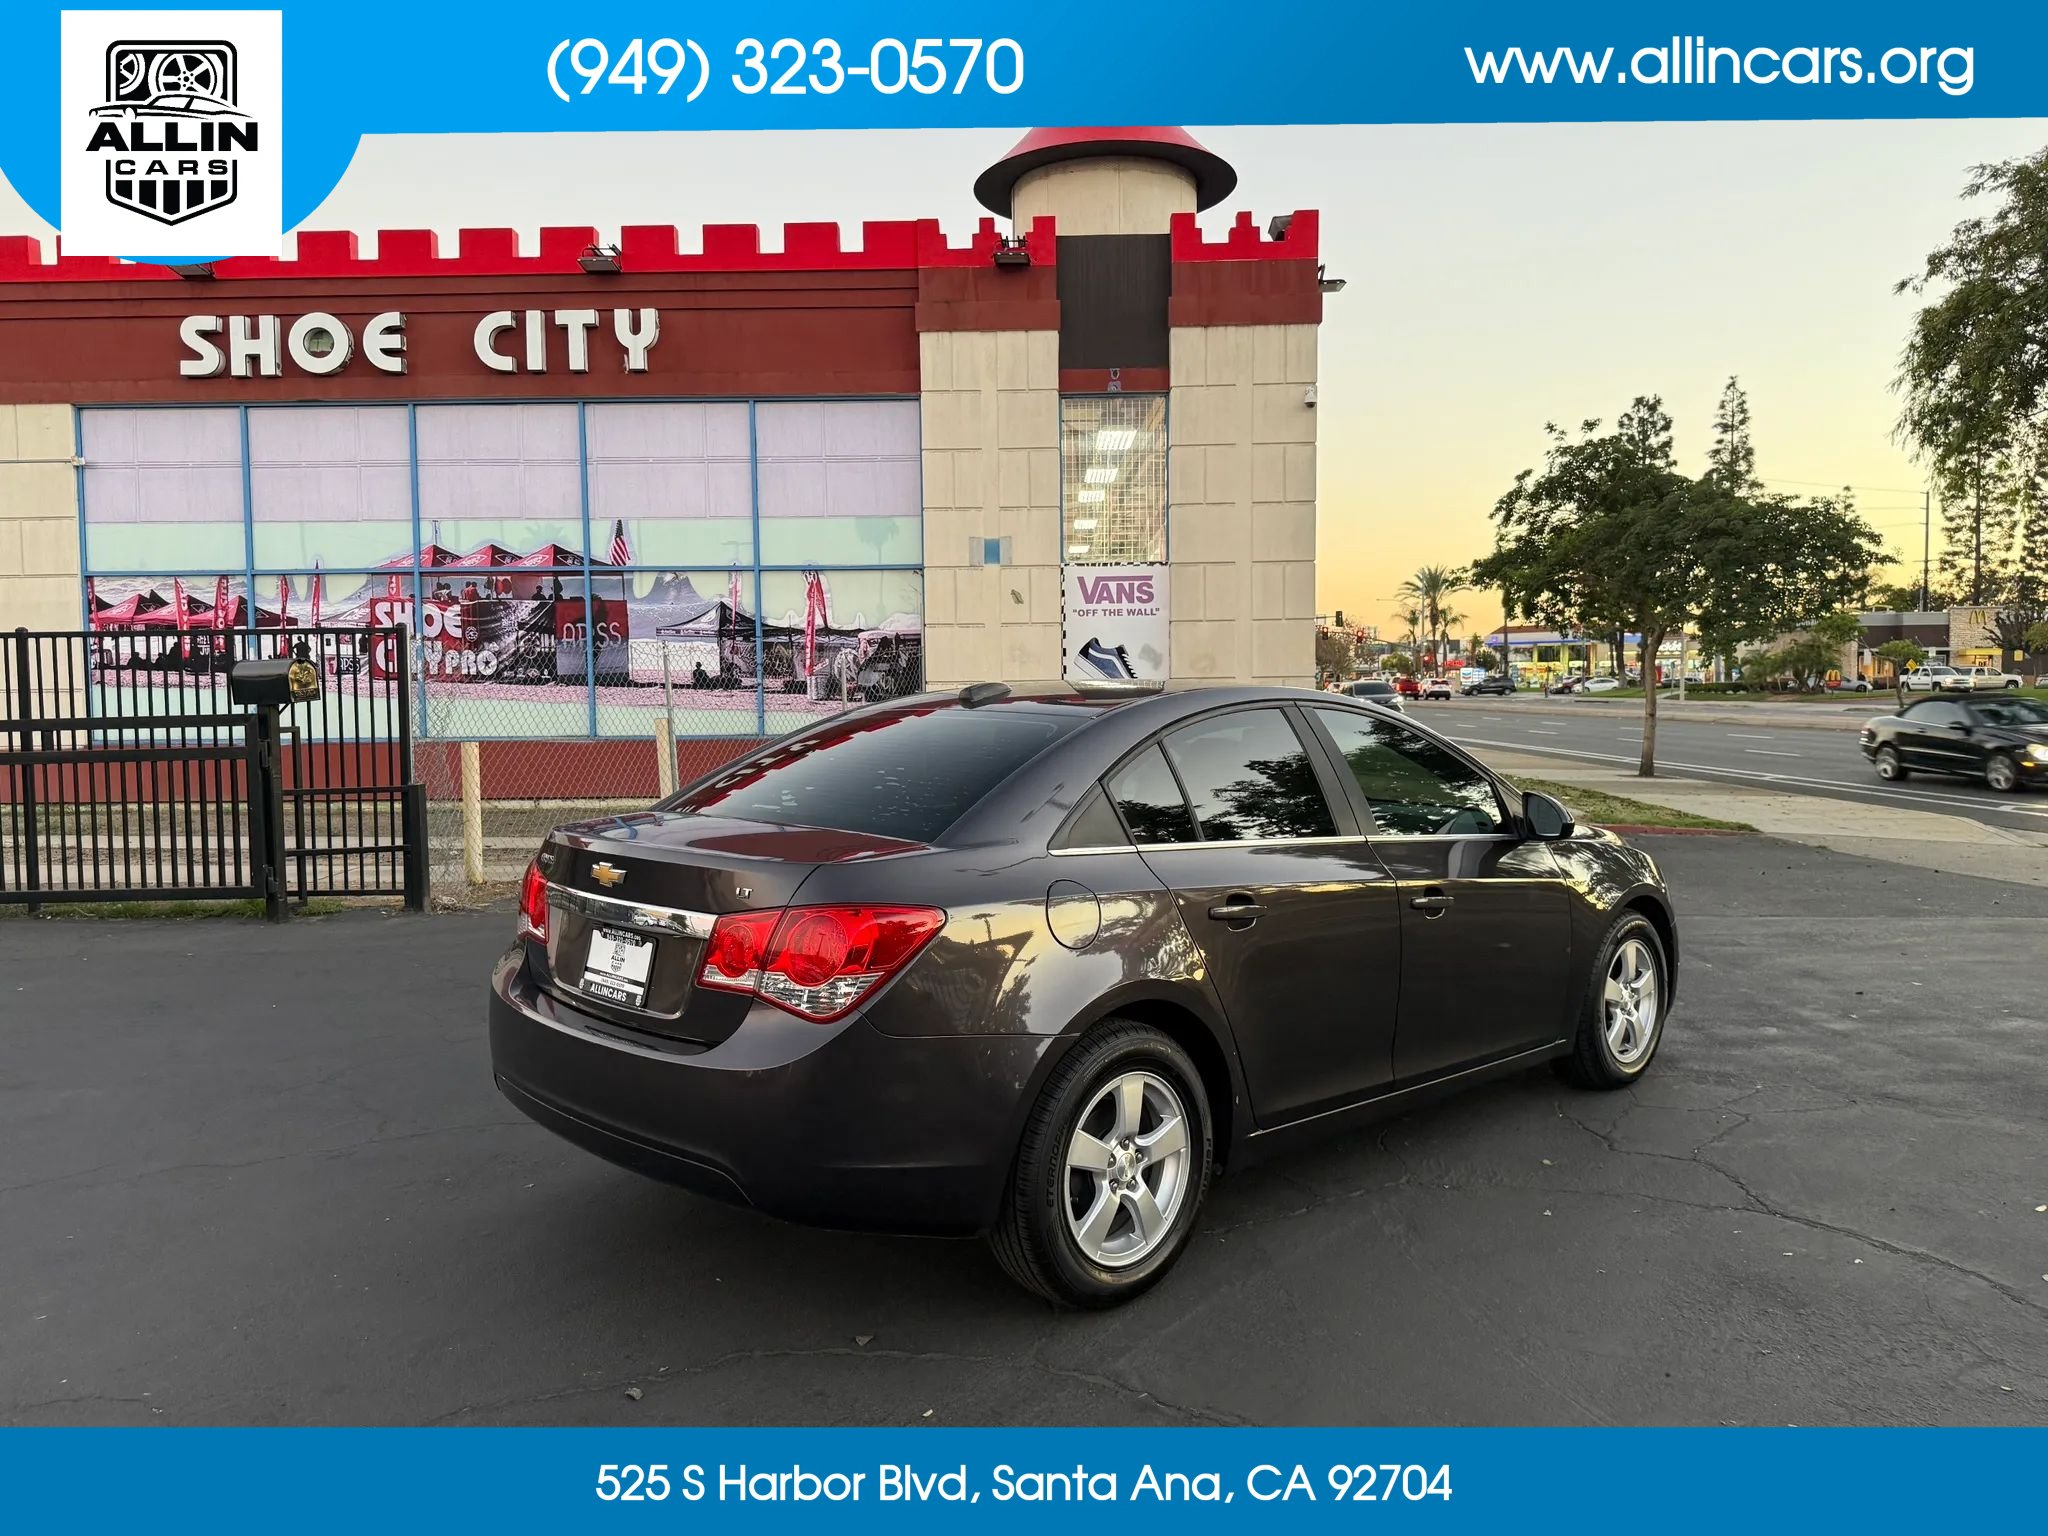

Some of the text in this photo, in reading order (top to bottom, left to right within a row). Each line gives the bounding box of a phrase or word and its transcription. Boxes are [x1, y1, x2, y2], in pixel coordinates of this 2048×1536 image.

[180, 308, 660, 378] SHOE CITY
[1077, 576, 1154, 604] VANS
[1073, 607, 1160, 617] "OFF THE WALL"
[736, 887, 753, 900] LT
[590, 983, 627, 1002] ALLINCARS
